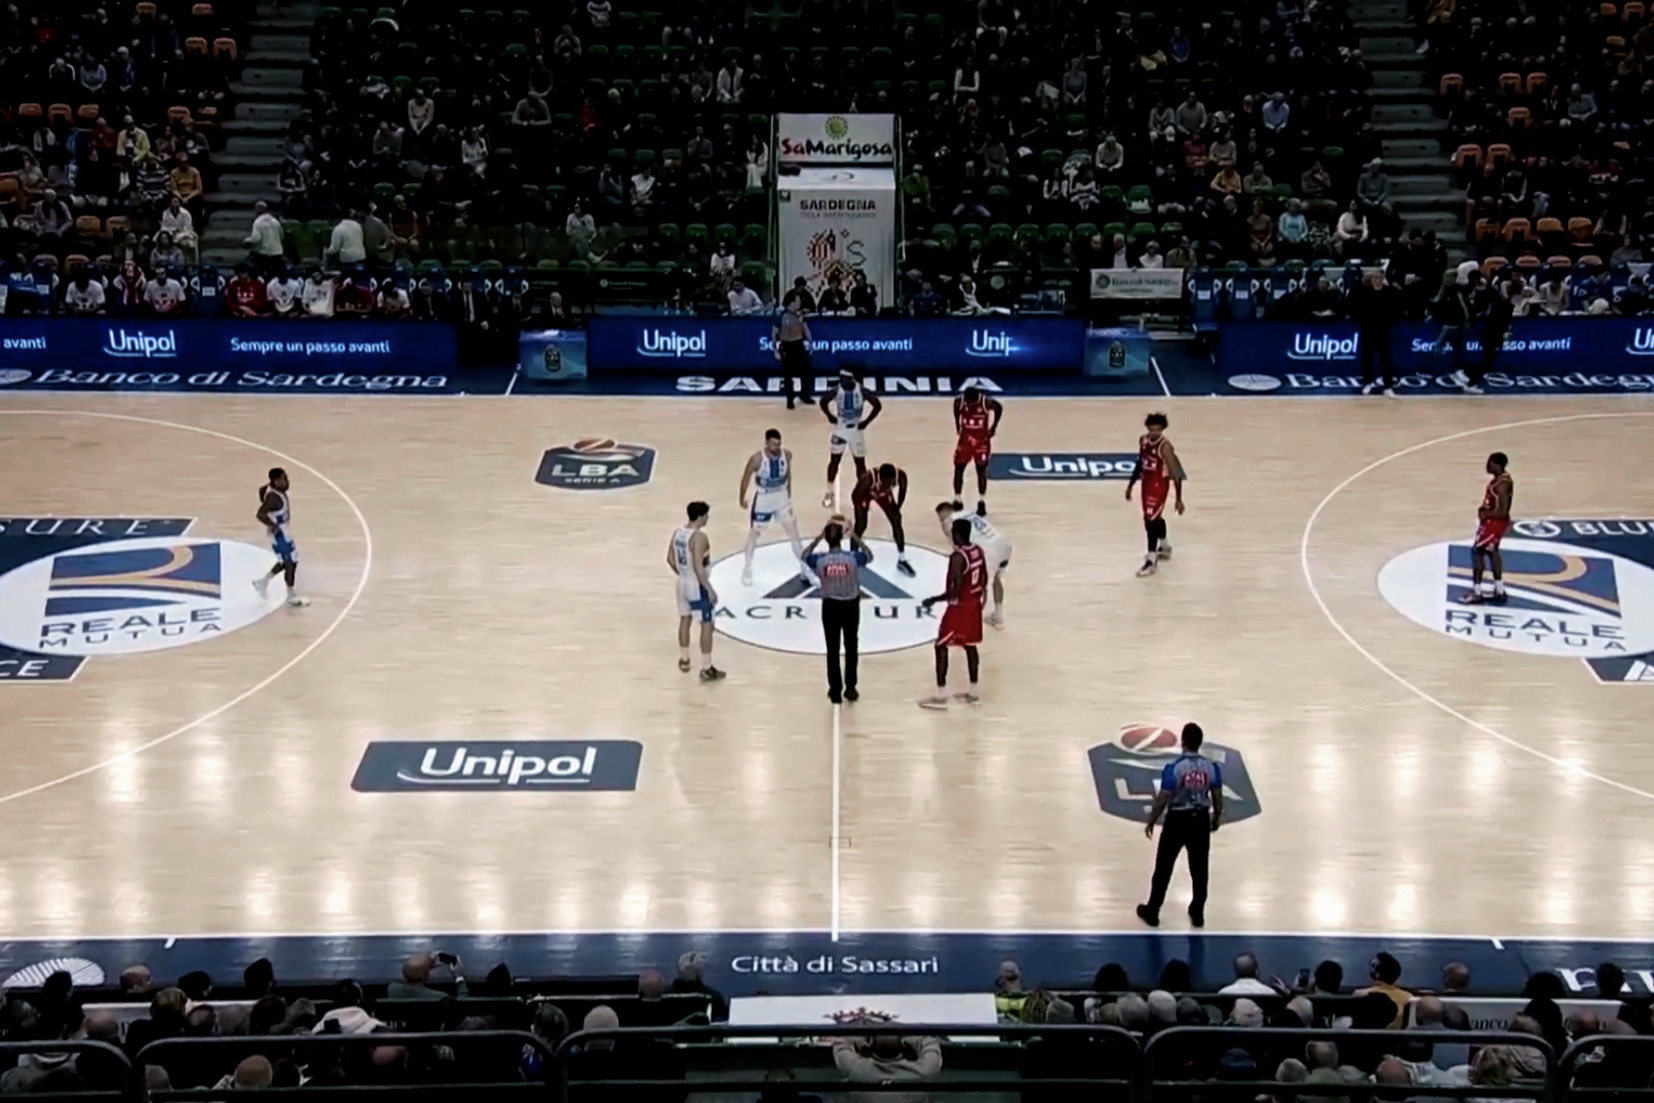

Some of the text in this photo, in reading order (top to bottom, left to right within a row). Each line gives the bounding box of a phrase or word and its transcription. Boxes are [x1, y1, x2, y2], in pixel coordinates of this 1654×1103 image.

[781, 138, 892, 159] SaMarigosa
[800, 200, 876, 210] SARDEGNA
[3, 337, 46, 349] avanti
[106, 329, 176, 357] Unipol
[231, 337, 391, 355] Sempre un passo avanti
[642, 329, 706, 357] Unipol
[832, 340, 869, 354] passo
[873, 338, 912, 350] avanti
[1294, 332, 1359, 360] Unipol
[1530, 337, 1571, 350] avanti
[34, 368, 448, 390] Banco di Sardegna
[552, 464, 640, 476] LBA
[1019, 456, 1136, 477] Unipo
[40, 607, 221, 638] REALE
[1446, 609, 1626, 641] REALE
[39, 622, 223, 649] MUTUA
[1446, 624, 1628, 652] MUTUA
[420, 746, 597, 785] Unipol
[731, 955, 939, 973] Città di Sassari
